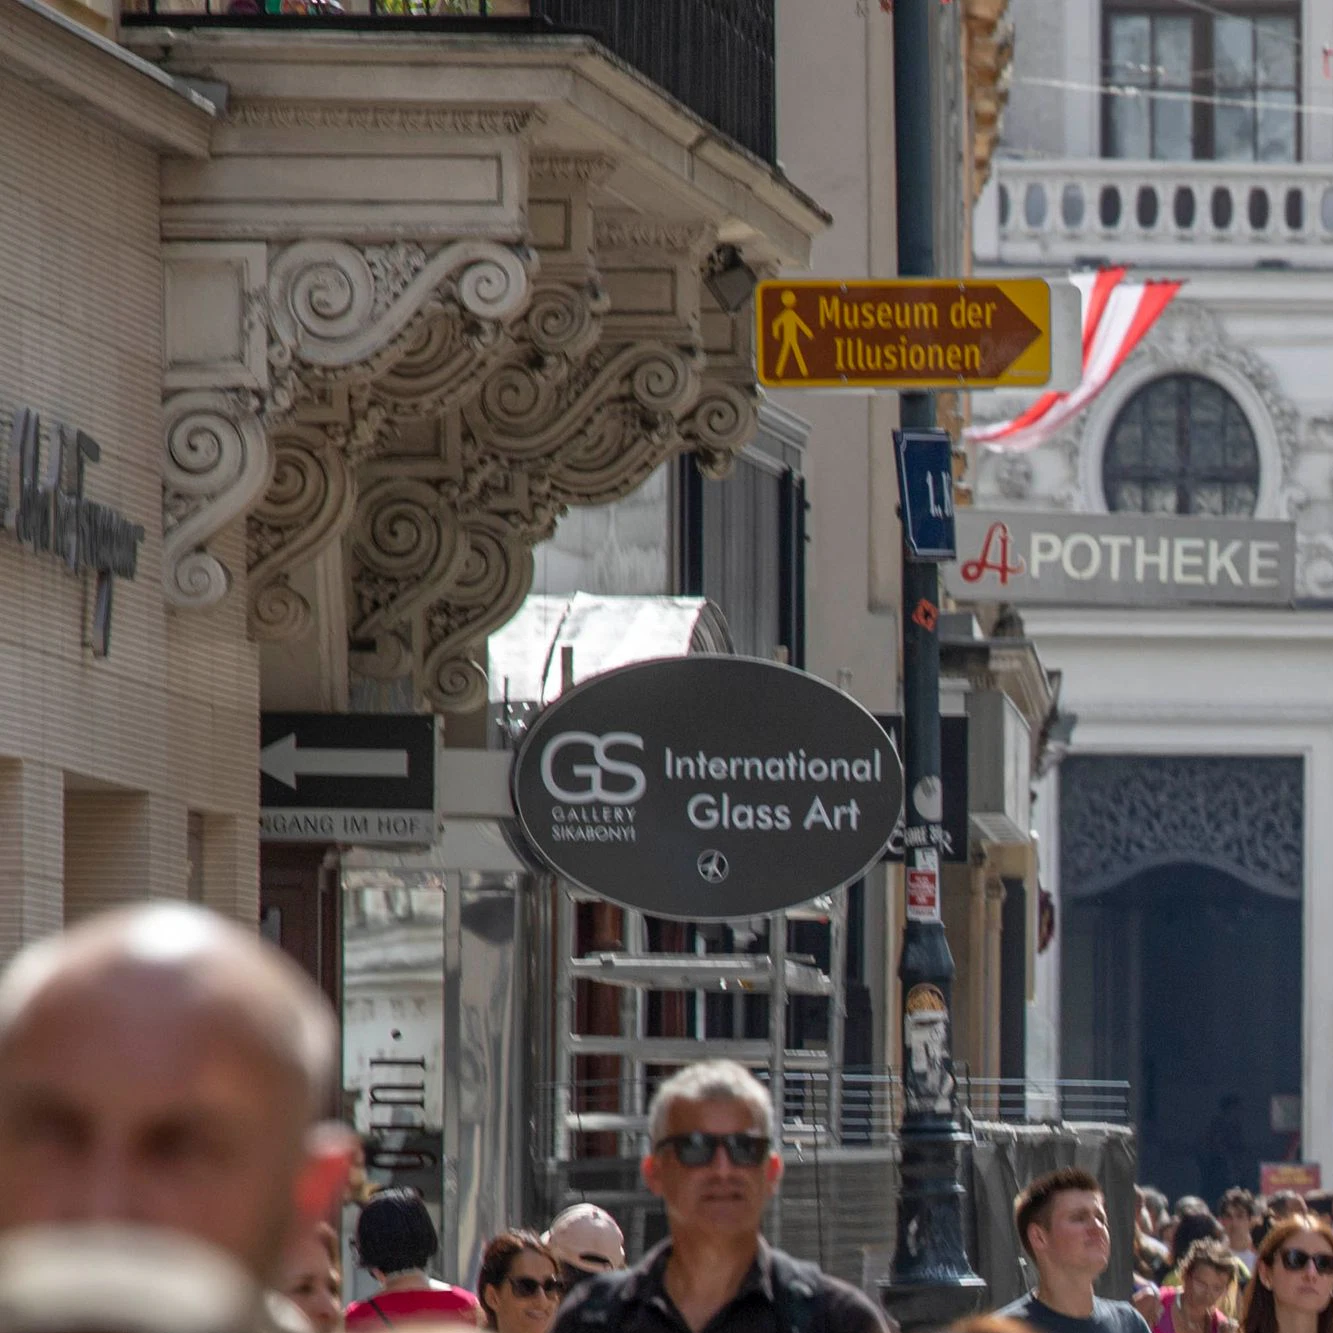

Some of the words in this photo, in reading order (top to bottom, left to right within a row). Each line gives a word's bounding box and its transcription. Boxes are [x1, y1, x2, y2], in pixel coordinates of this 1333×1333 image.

[818, 295, 938, 329] Museum
[949, 295, 997, 329] der
[834, 336, 981, 371] Illusionen
[960, 521, 1281, 586] APOTHEKE
[540, 731, 647, 806] GS
[664, 747, 882, 783] International
[343, 815, 369, 835] IM
[377, 816, 422, 836] HOF
[551, 805, 637, 823] GALLERY
[687, 793, 791, 831] Glass
[803, 796, 861, 831] Art
